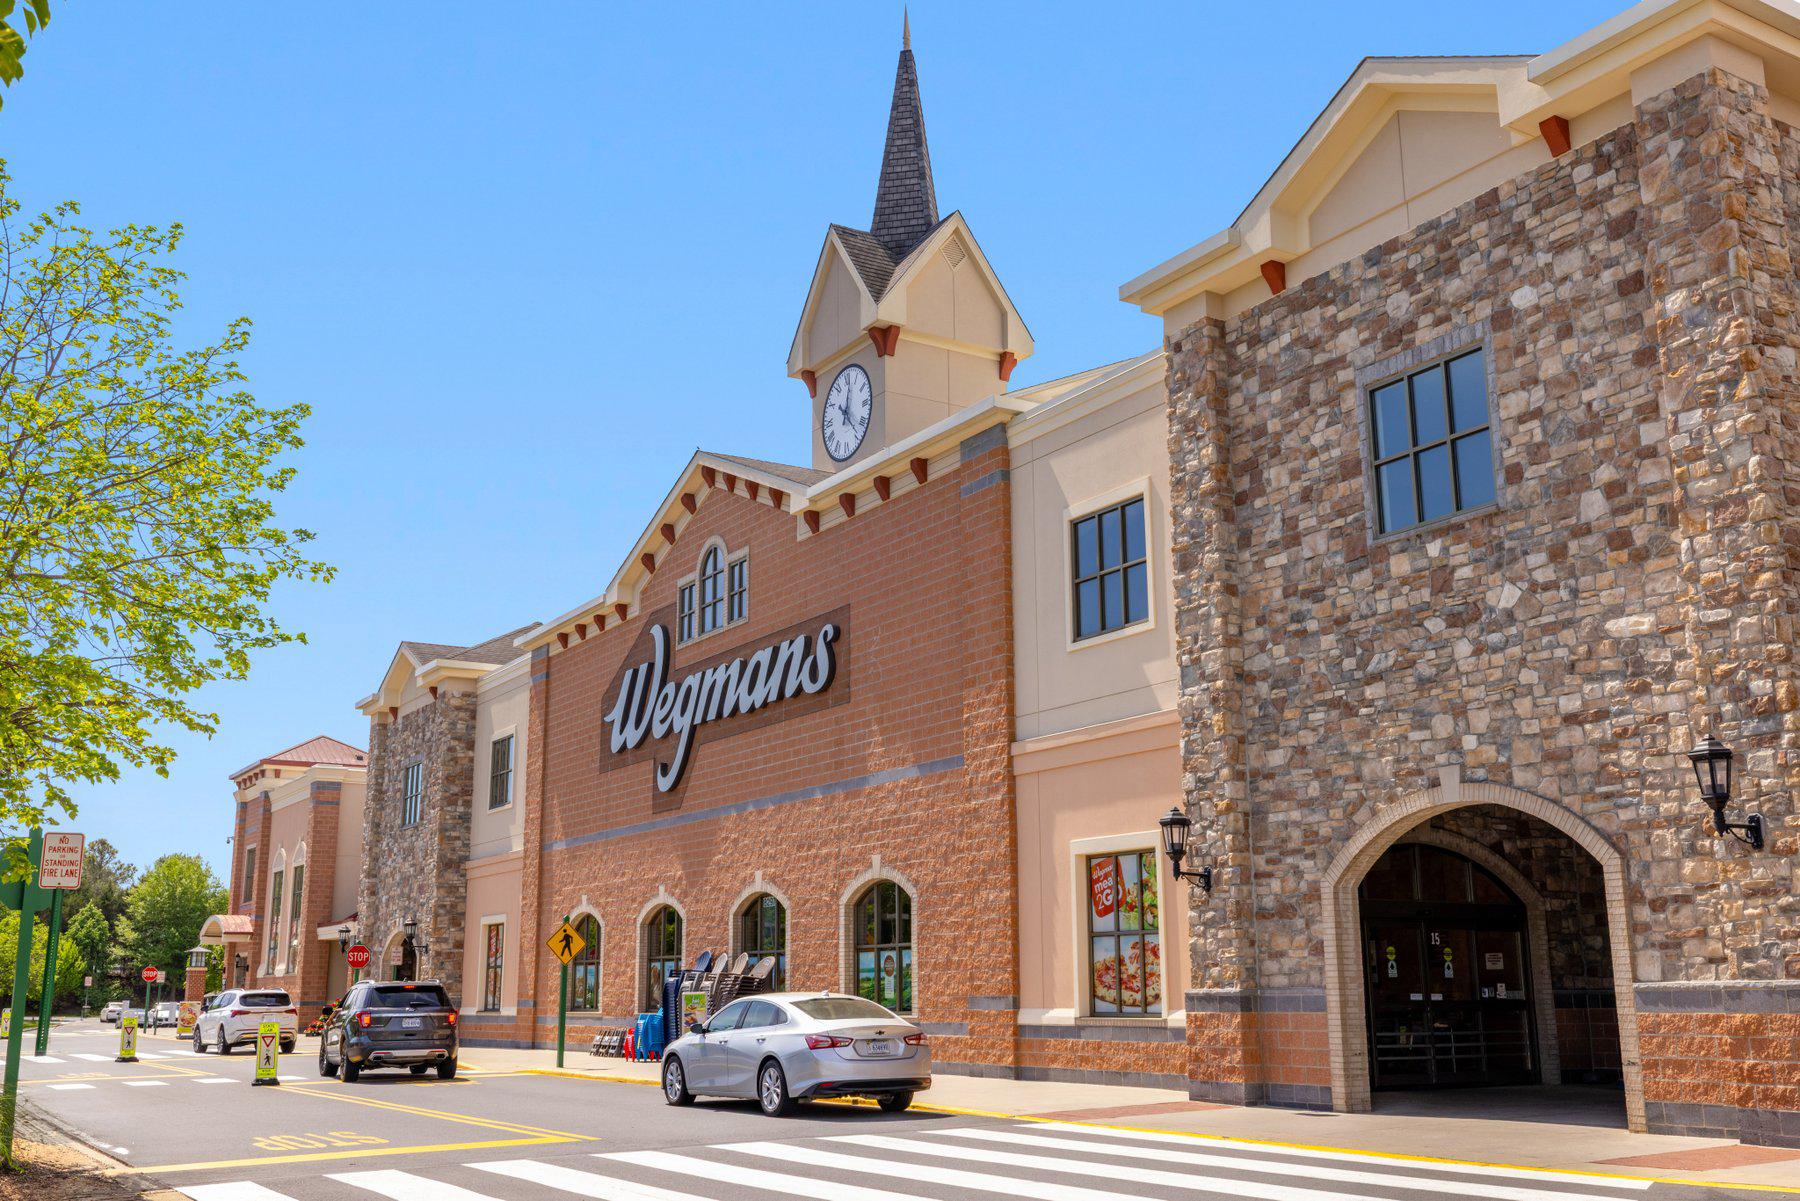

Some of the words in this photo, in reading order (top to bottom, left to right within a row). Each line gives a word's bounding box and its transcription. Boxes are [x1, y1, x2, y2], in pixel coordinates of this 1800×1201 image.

[603, 624, 840, 792] Wegmans
[43, 868, 58, 877] FIRE
[60, 868, 78, 877] LANE
[1094, 876, 1119, 894] mea
[1430, 932, 1441, 945] 15
[348, 952, 369, 961] STOP
[252, 1131, 390, 1150] STOP
